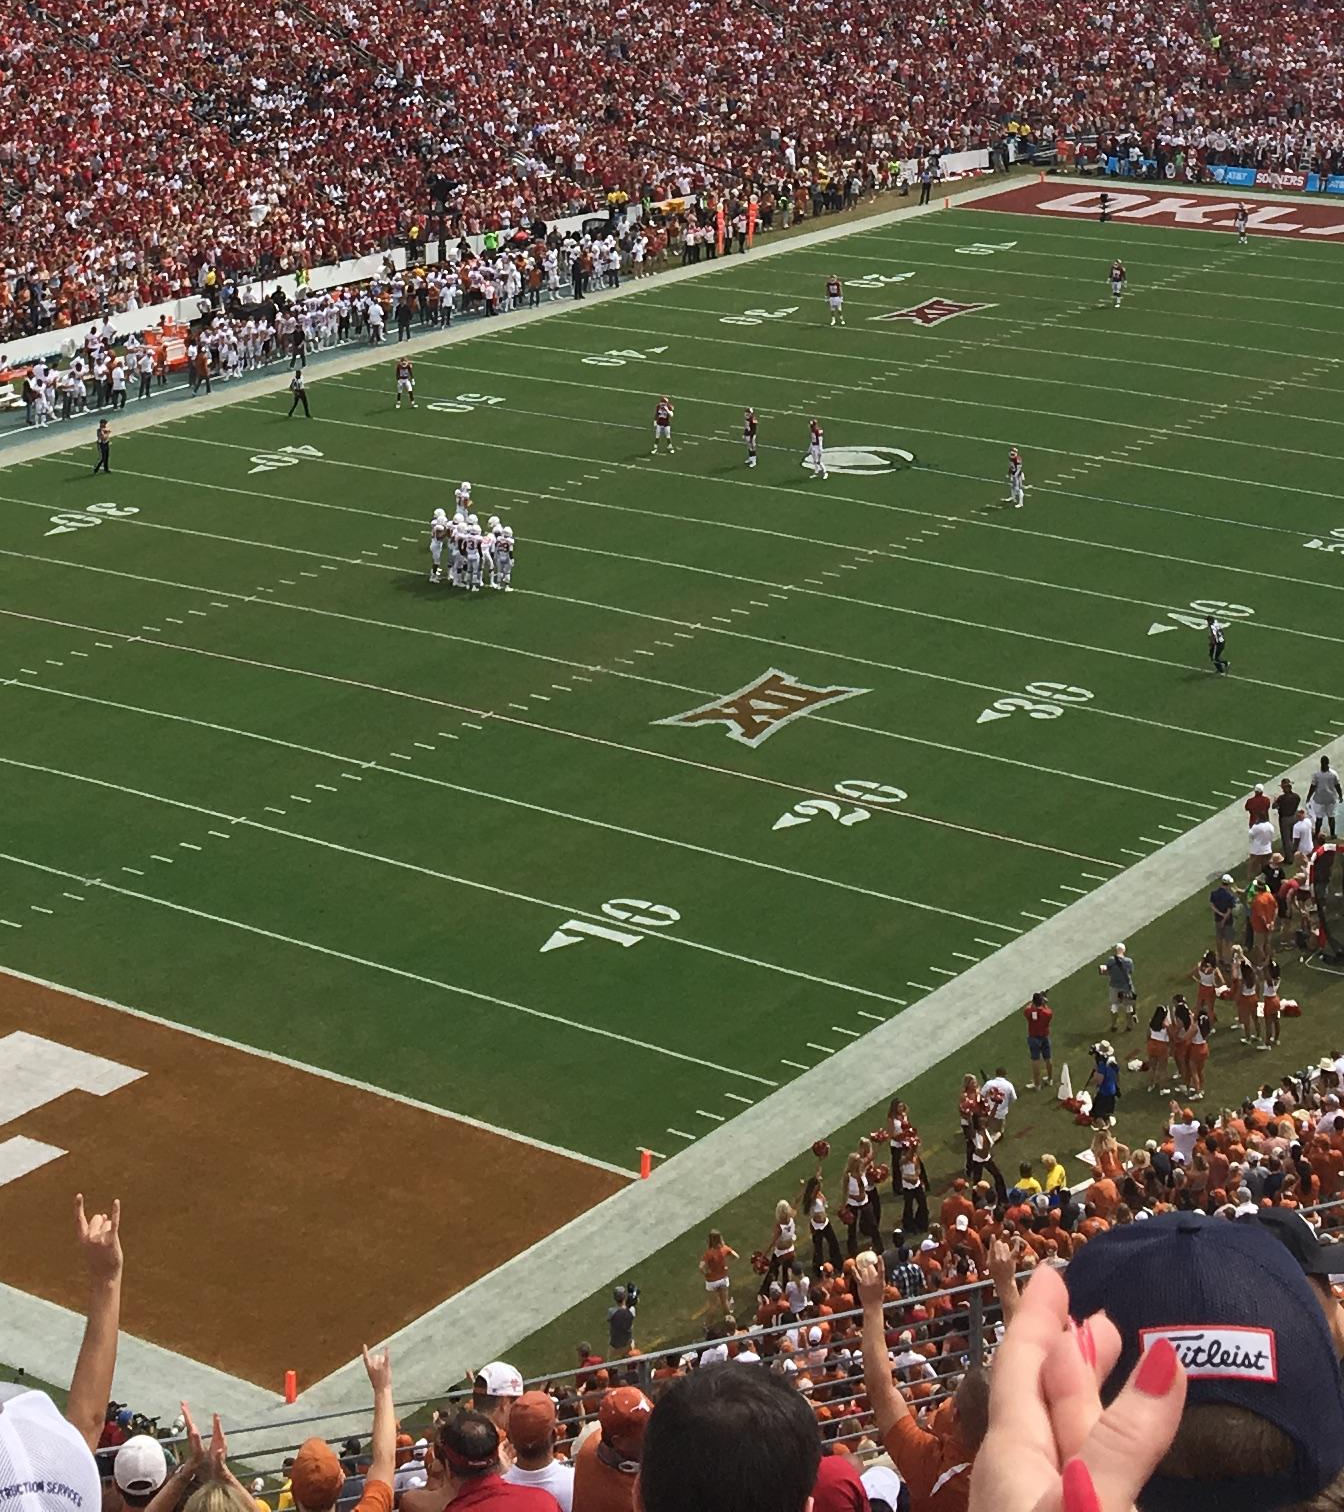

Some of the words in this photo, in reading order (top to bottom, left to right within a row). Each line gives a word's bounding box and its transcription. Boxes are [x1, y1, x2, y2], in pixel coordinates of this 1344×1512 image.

[1256, 174, 1304, 186] SONERS
[54, 501, 141, 529] 30
[1167, 599, 1256, 631] 40
[993, 681, 1094, 721] 30
[792, 779, 909, 826] 20
[567, 898, 680, 948] 10
